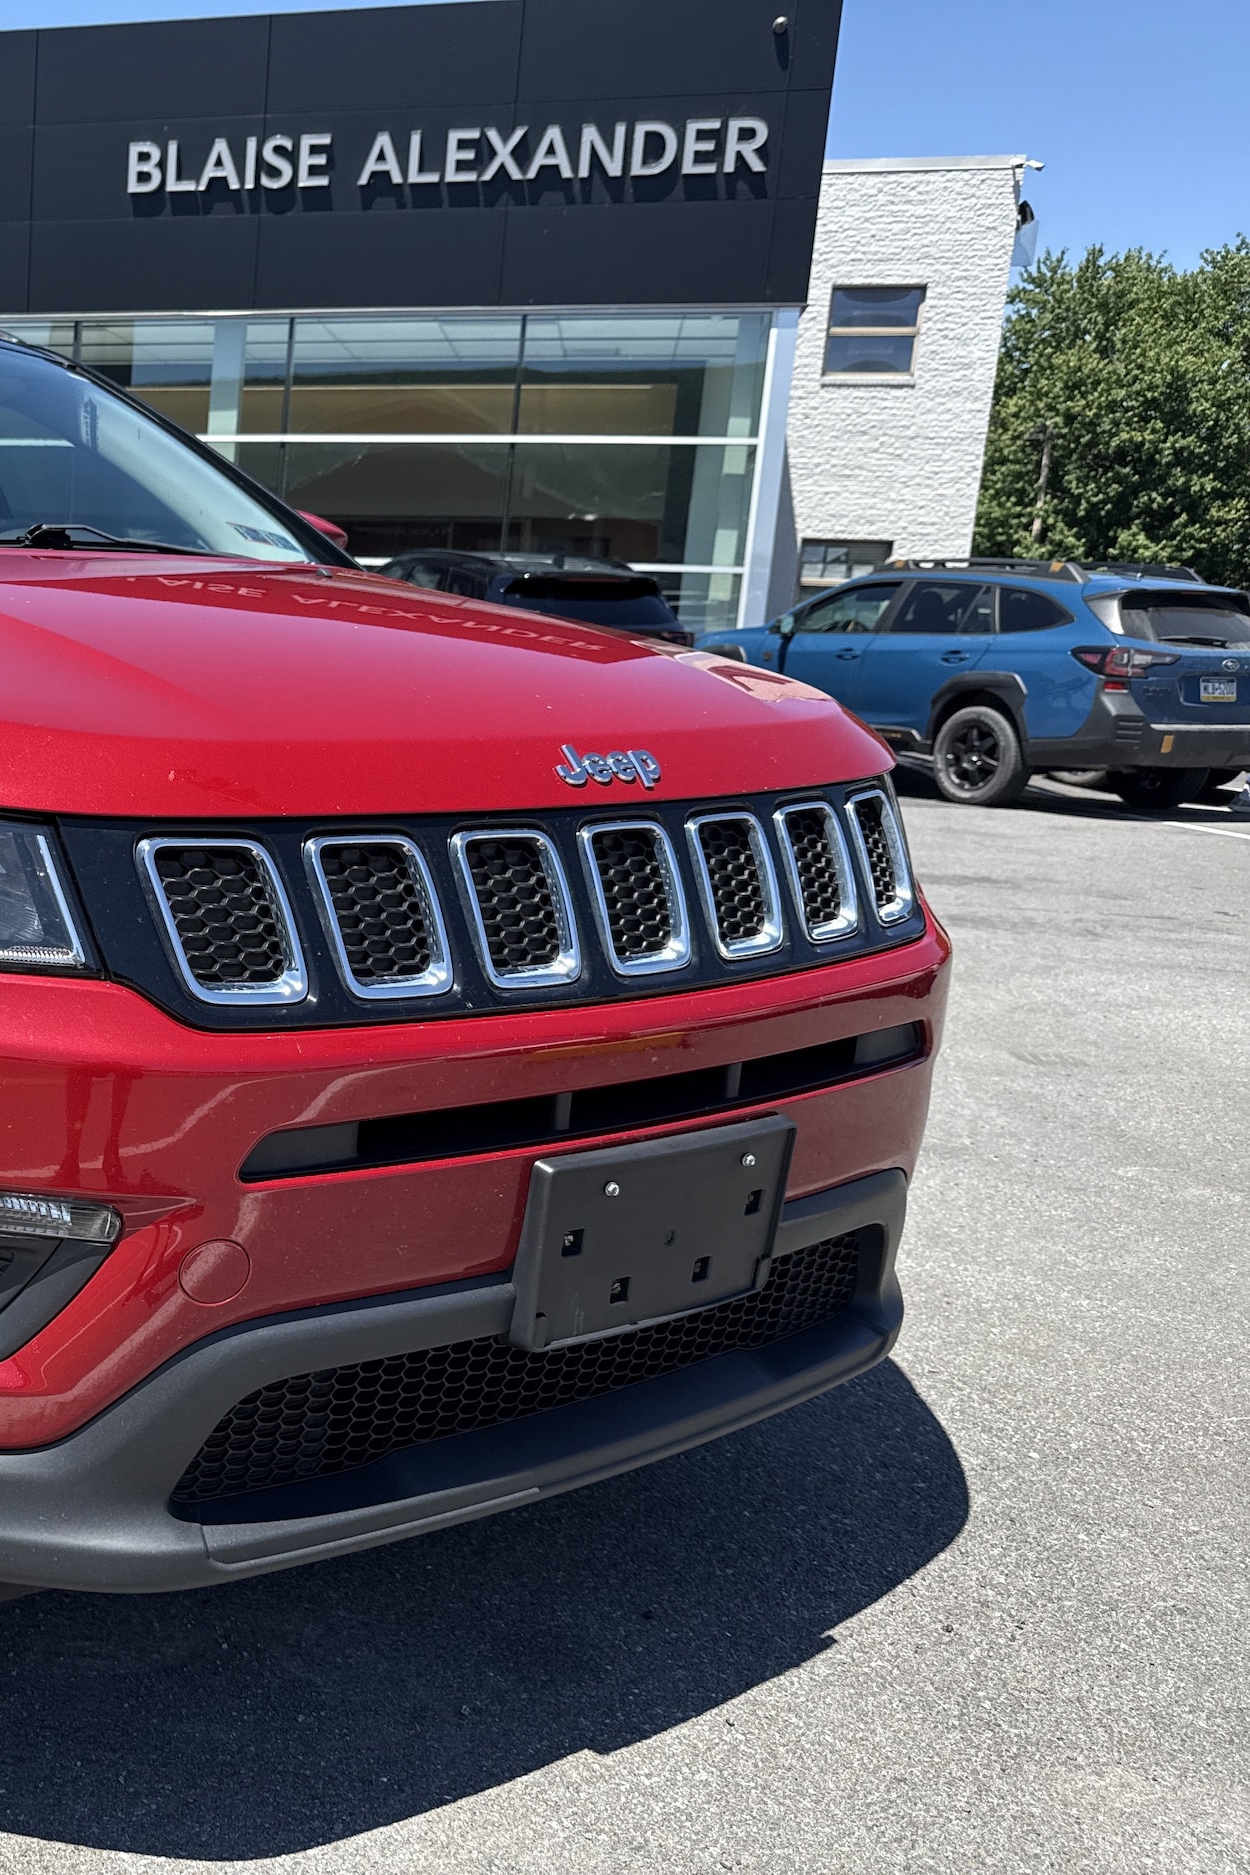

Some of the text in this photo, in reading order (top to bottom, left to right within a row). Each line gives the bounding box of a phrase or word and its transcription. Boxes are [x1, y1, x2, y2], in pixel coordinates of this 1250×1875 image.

[126, 117, 768, 194] BLAISE ALEXANDER
[554, 744, 661, 789] Jeep
